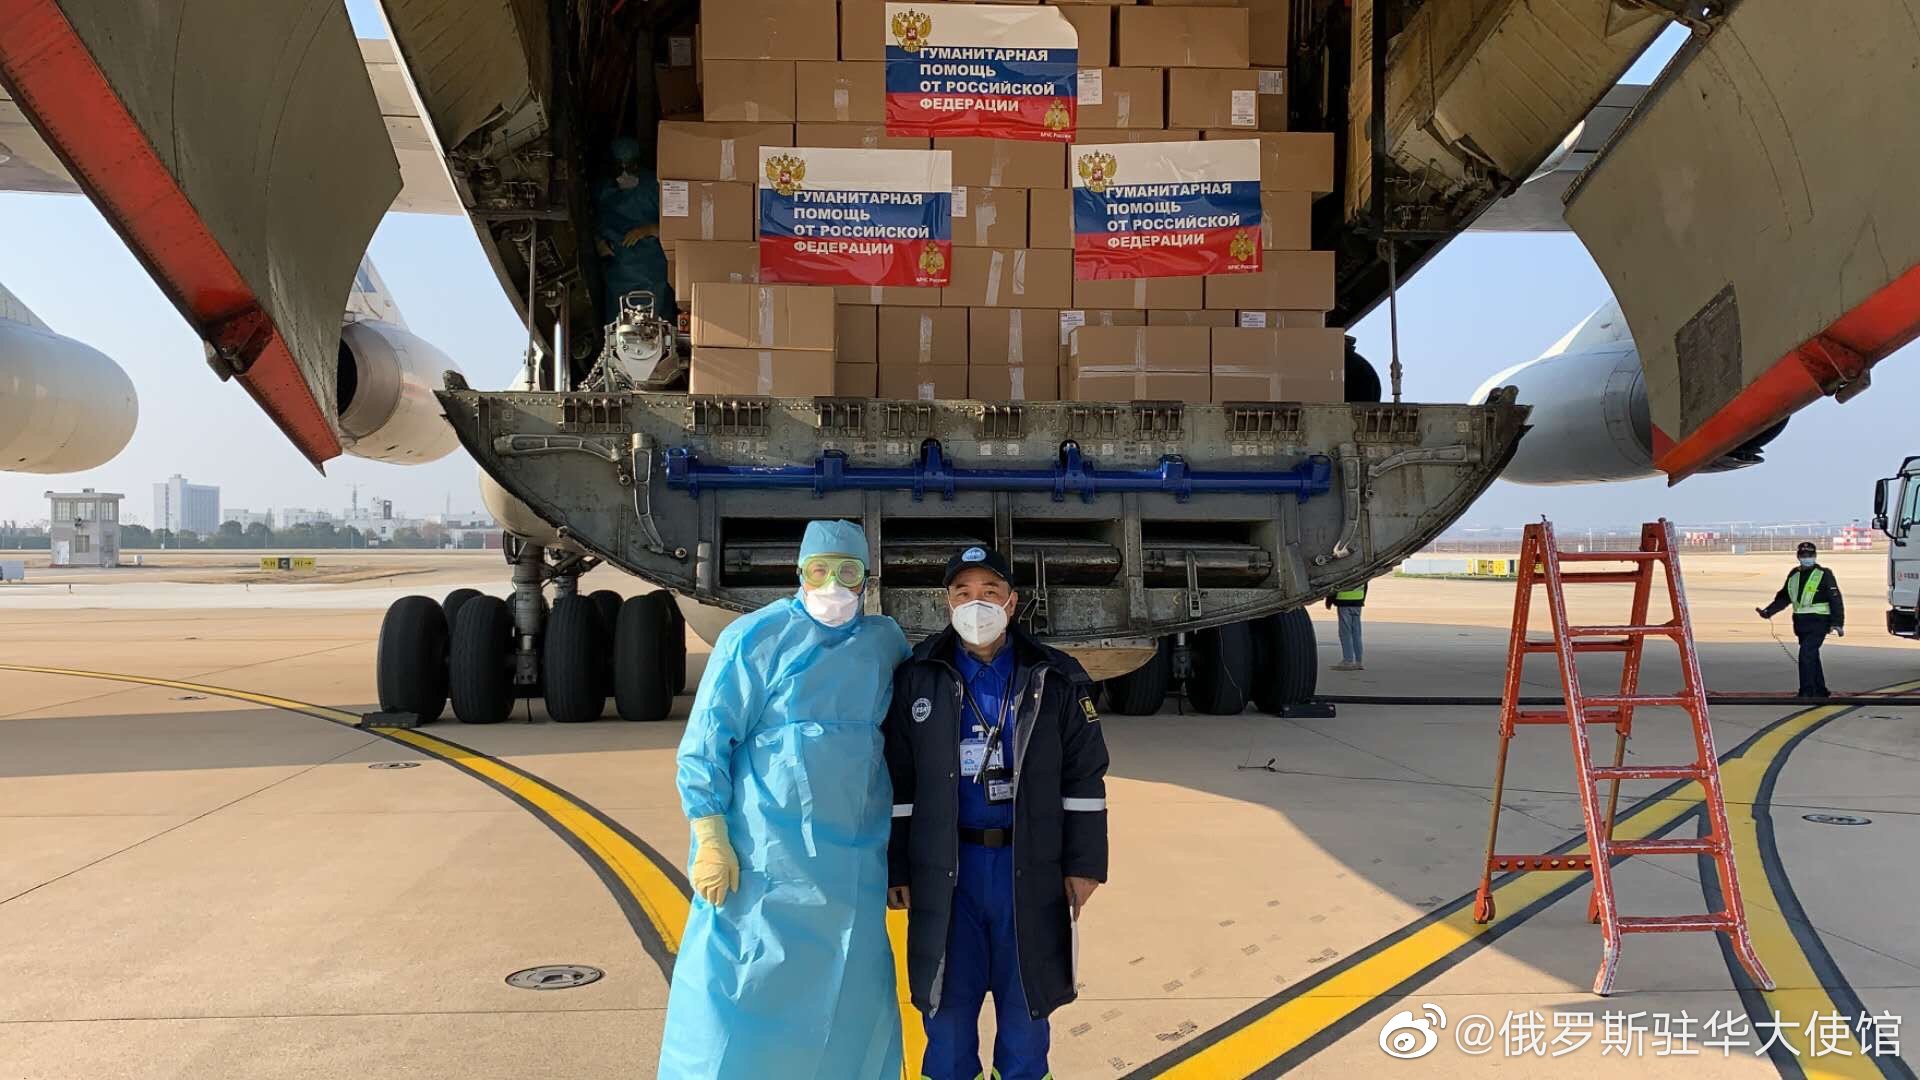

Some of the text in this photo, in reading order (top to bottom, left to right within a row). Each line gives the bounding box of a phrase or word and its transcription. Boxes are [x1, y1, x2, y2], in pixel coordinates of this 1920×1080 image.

[919, 47, 1048, 61] ГУМАНИТАРНАЯ
[919, 63, 996, 78] ПОМОЩЬ
[919, 80, 1055, 95] ОТ РОССИЙСКОЙ
[919, 97, 1019, 112] ФЕДЕРАЦИИ
[1105, 182, 1232, 198] ГУМАНИТАРНАЯ
[793, 191, 923, 205] ГУМАНИТАРНАЯ
[793, 207, 871, 222] ПОМОЩЬ
[1106, 201, 1182, 216] ПОМОЩЬ
[1107, 213, 1240, 232] ОТ РОССИЙСКОЙ
[793, 224, 929, 239] ОТ РОССИЙСКОЙ
[793, 241, 894, 255] ФЕДЕРАЦИИ
[1107, 234, 1205, 249] ФЕДЕРАЦИИ
